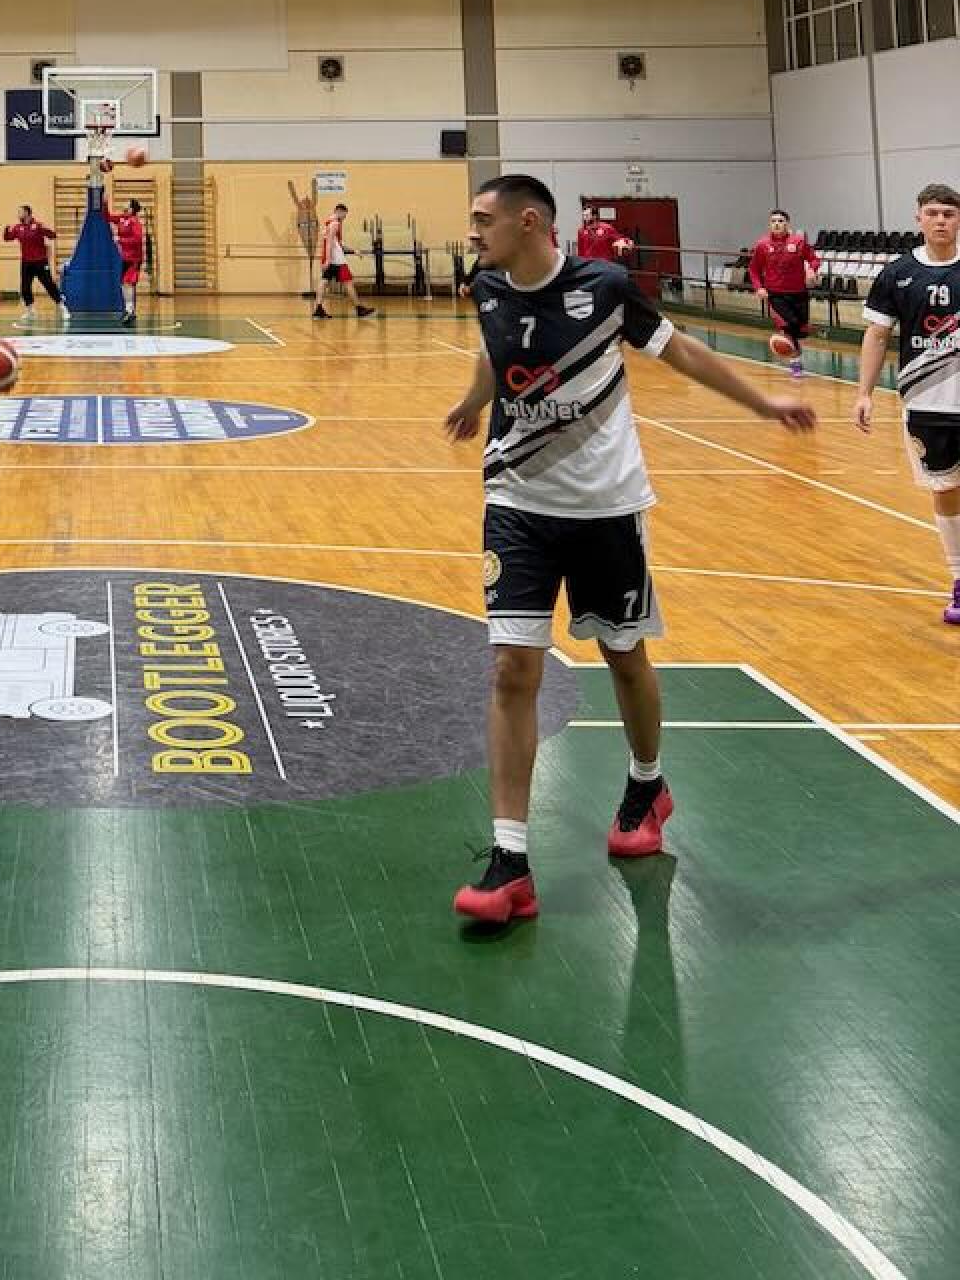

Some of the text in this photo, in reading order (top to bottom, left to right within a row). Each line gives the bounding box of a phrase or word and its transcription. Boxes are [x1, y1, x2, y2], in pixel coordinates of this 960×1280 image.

[927, 284, 951, 307] 79
[519, 315, 537, 350] 7
[623, 589, 640, 619] 7
[133, 582, 253, 775] BOOTLEGGER
